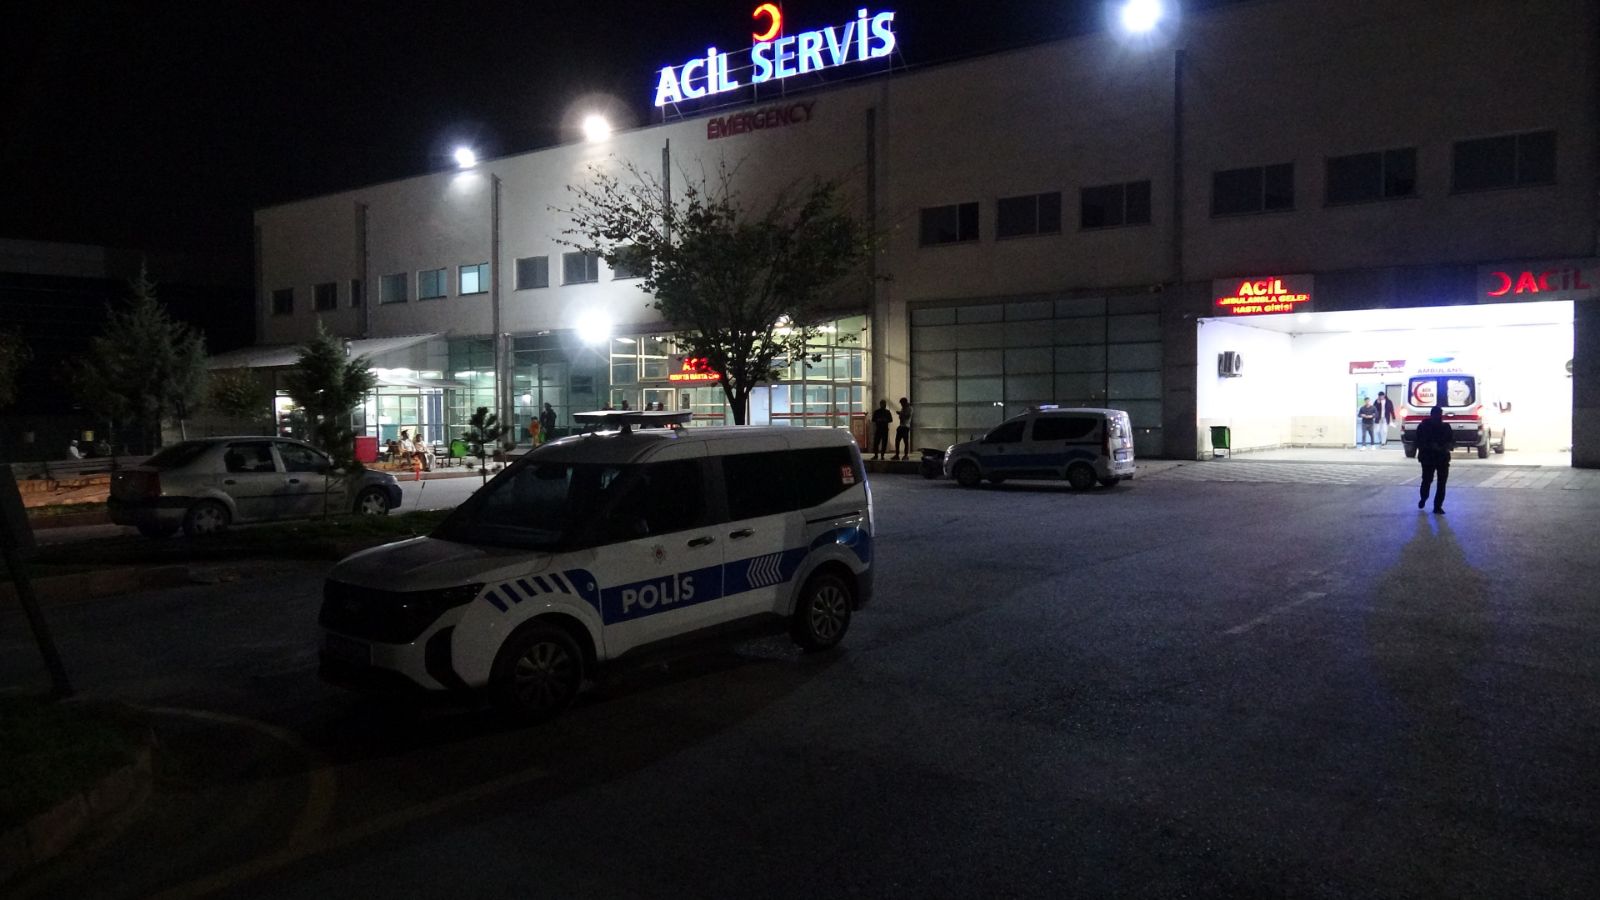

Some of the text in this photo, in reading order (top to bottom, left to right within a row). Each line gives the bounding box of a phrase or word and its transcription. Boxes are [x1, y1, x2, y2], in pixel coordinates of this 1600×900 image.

[654, 8, 897, 107] ACİL SERVİS
[707, 101, 816, 140] EMERGENCY
[1238, 277, 1287, 296] ACİL
[1514, 267, 1592, 294] ACİL
[841, 465, 854, 478] 112
[622, 572, 695, 614] POLİS
